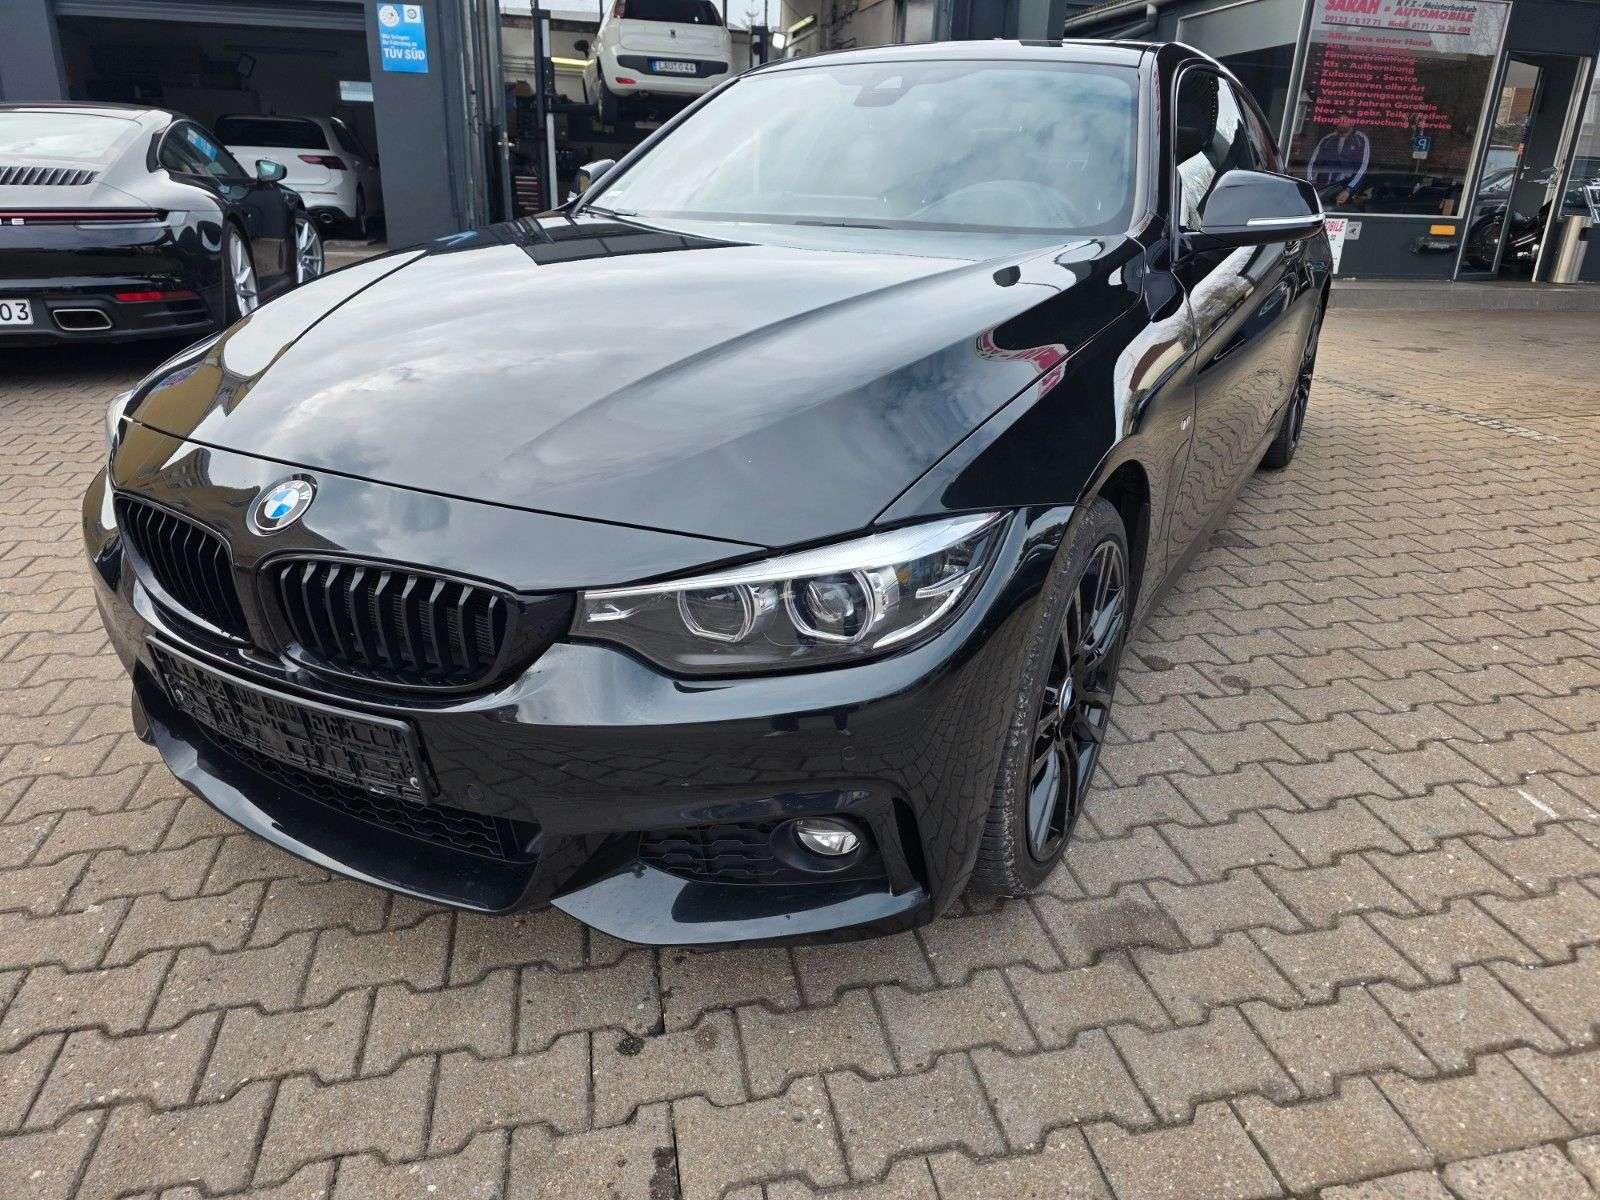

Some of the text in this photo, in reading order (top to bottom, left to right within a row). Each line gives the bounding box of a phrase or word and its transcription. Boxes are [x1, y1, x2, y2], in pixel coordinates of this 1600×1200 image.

[1393, 7, 1475, 22] AUTOMOBILE
[1375, 36, 1401, 44] einer
[1405, 38, 1431, 47] Hand
[383, 46, 426, 60] TÜV SÜD
[1350, 63, 1415, 74] Aufbereitung
[1321, 70, 1373, 80] Zulassung
[1383, 74, 1418, 82] Service
[1322, 88, 1424, 101] Versicherungsservice
[1359, 100, 1391, 108] Jahren
[1394, 103, 1437, 111] Garantie
[1314, 106, 1335, 114] Neu
[1416, 112, 1448, 120] Reifen
[1313, 116, 1409, 128] Hauptuntersuchung
[1418, 121, 1451, 129] Service
